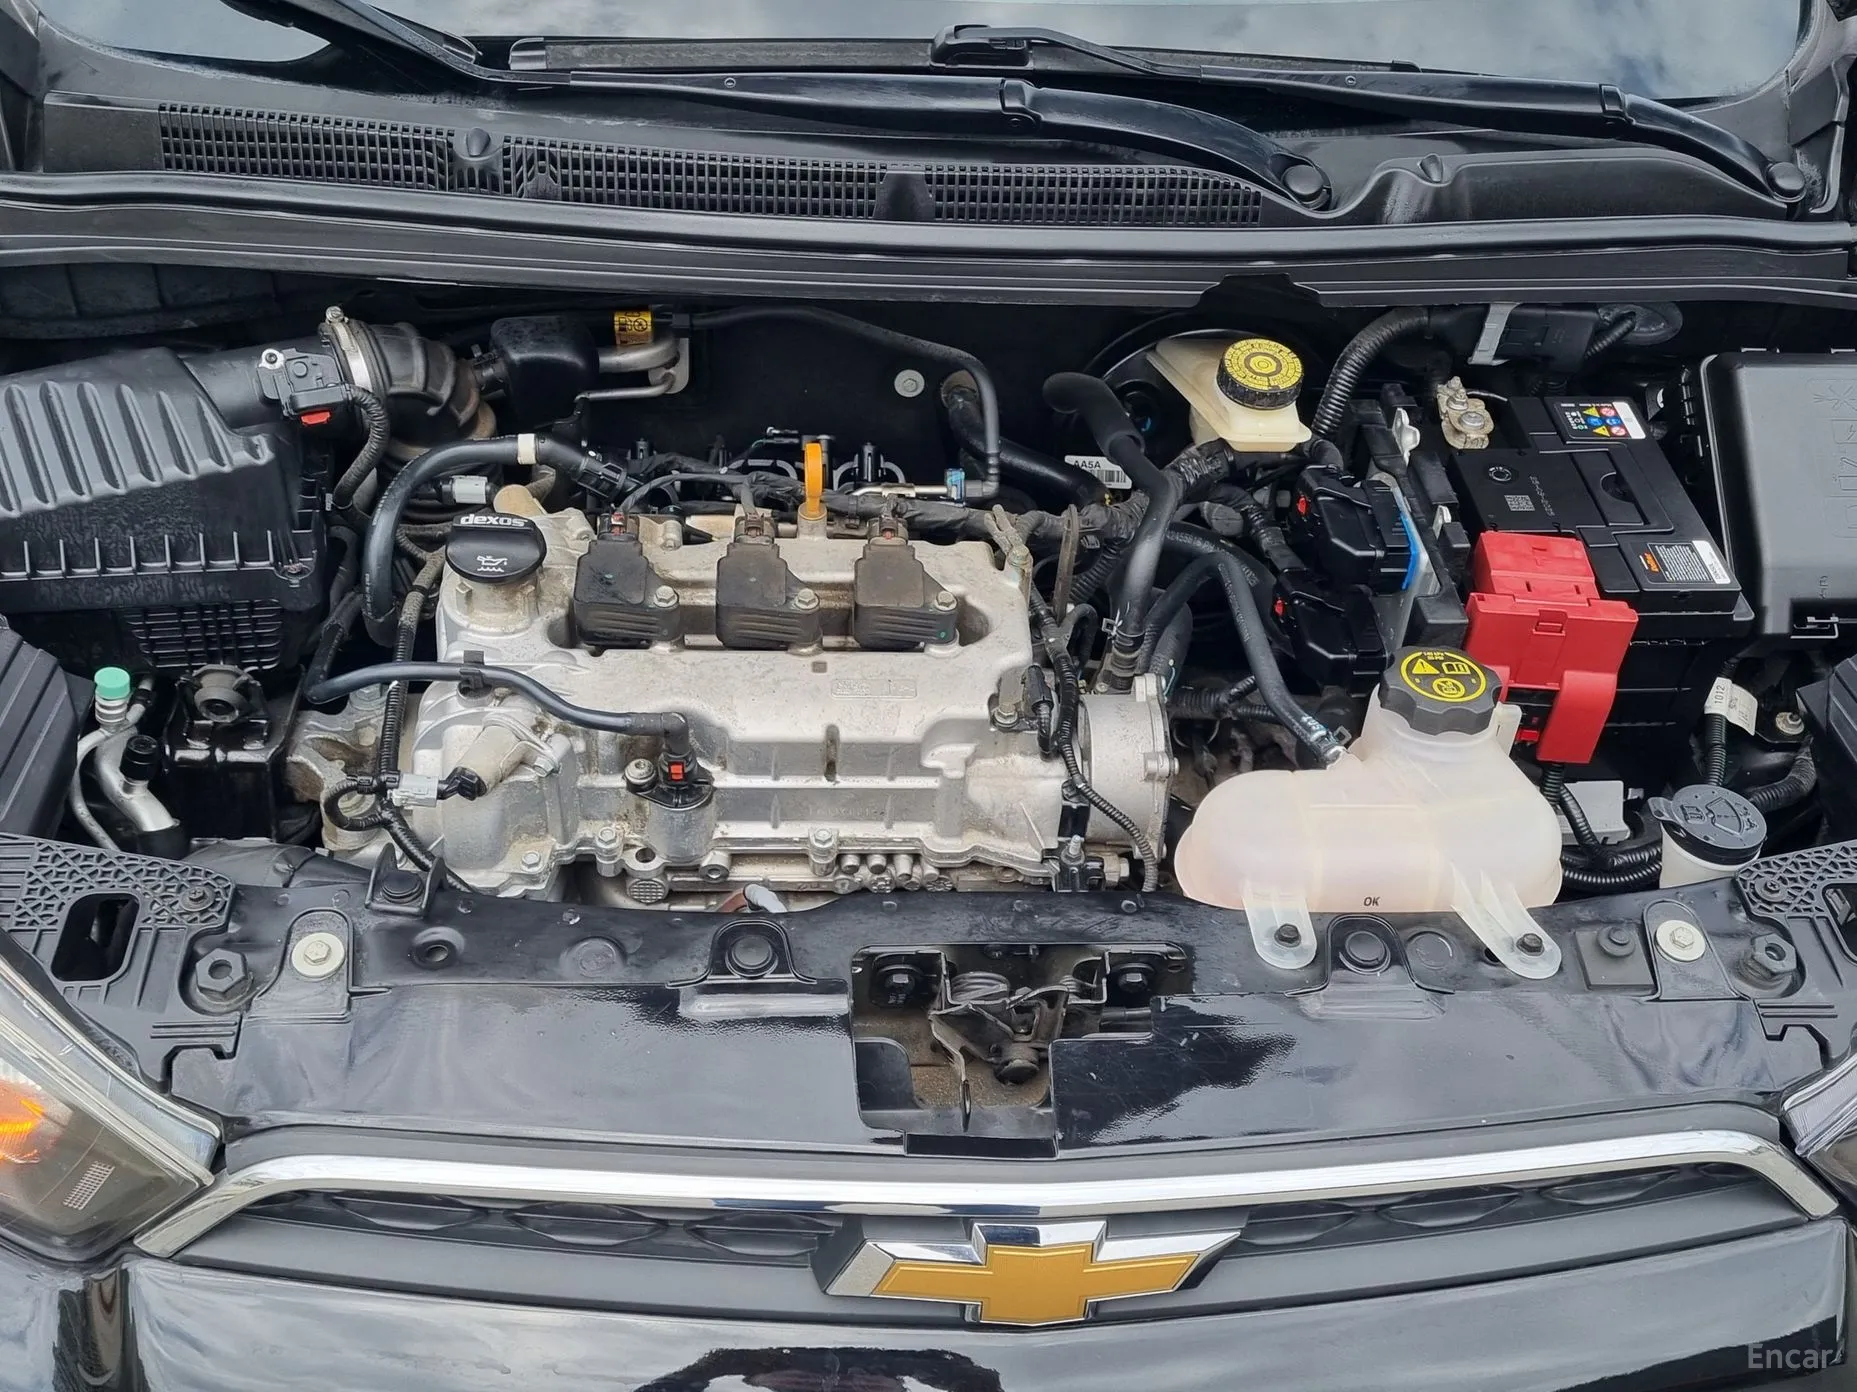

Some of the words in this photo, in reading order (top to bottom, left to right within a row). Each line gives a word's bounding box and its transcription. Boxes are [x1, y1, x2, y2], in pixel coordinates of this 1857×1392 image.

[1073, 460, 1101, 469] AA5A
[460, 513, 529, 527] dexos
[1714, 685, 1726, 704] 1012
[1363, 896, 1381, 907] OK
